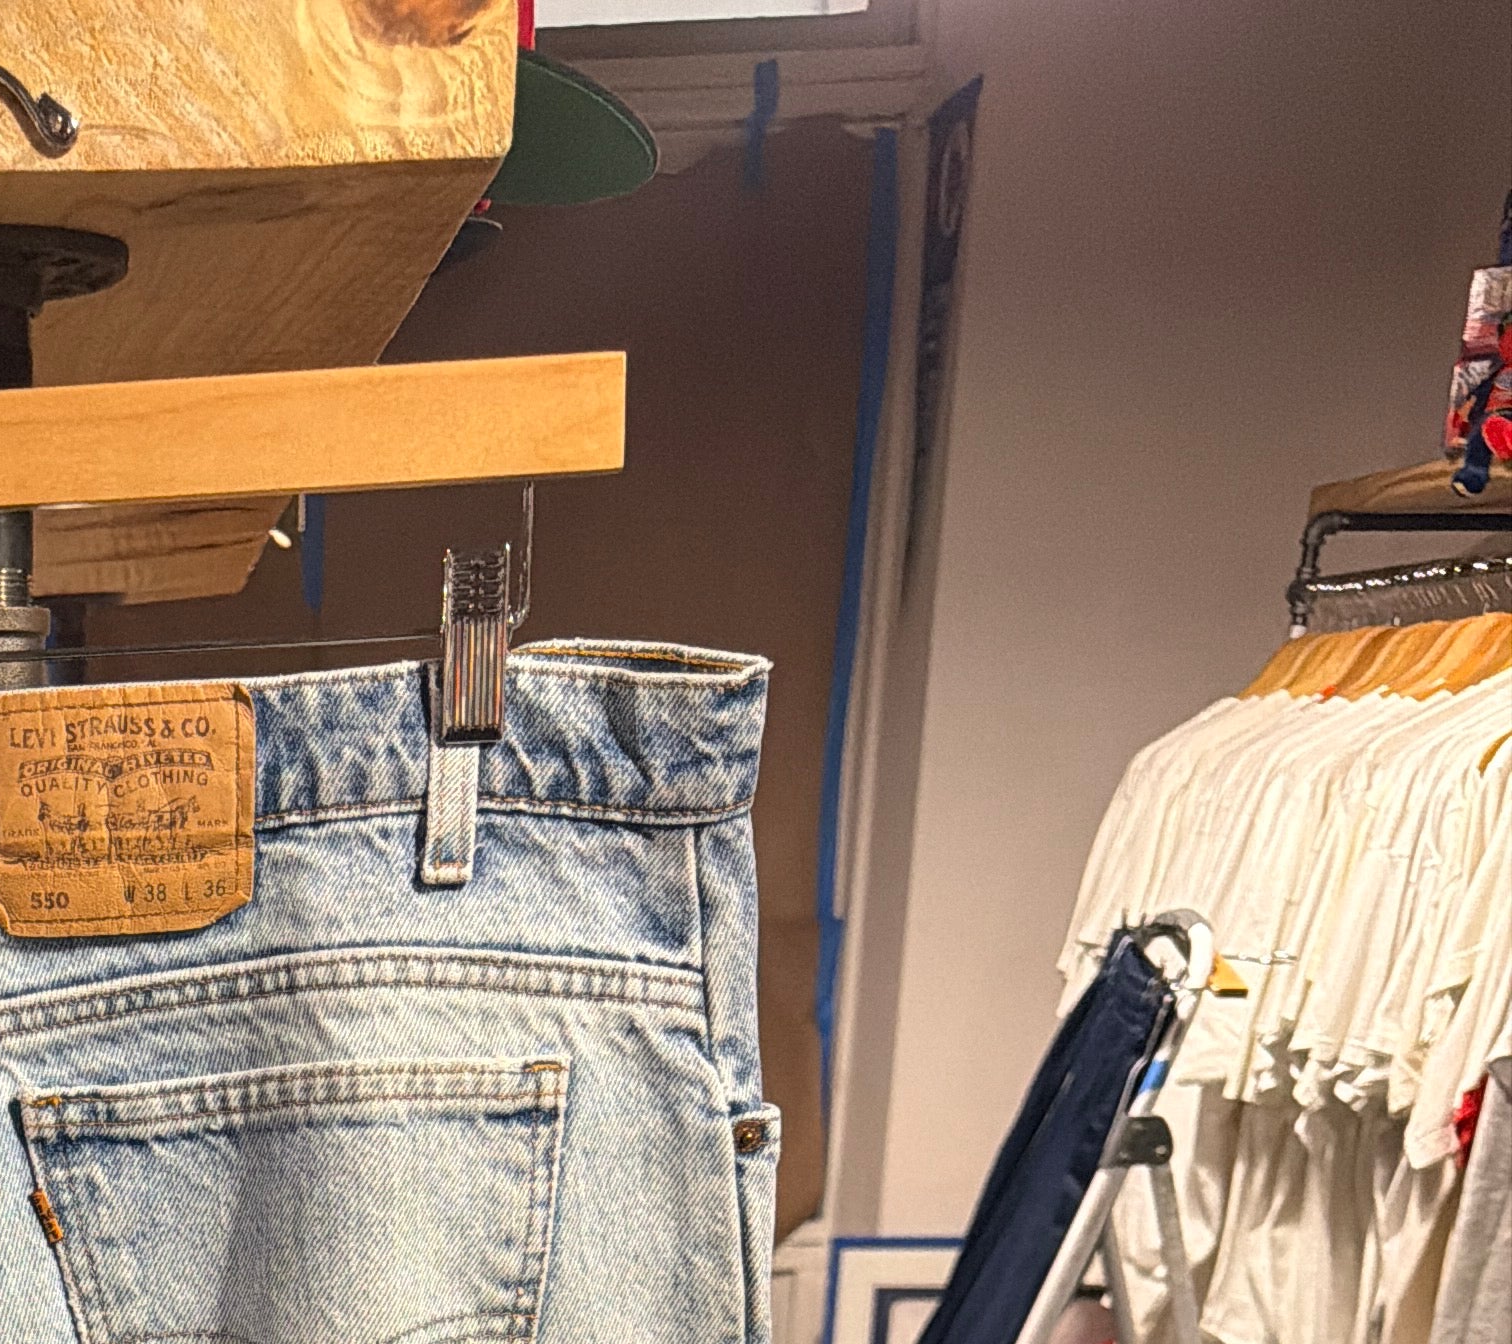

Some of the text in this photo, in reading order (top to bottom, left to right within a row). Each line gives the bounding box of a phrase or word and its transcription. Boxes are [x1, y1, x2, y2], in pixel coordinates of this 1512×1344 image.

[10, 714, 217, 749] LEVI STRAUSS & CO.
[20, 768, 209, 798] QUALITY CLOTHING
[30, 891, 70, 910] 550
[144, 882, 168, 902] 38
[202, 878, 226, 899] 36
